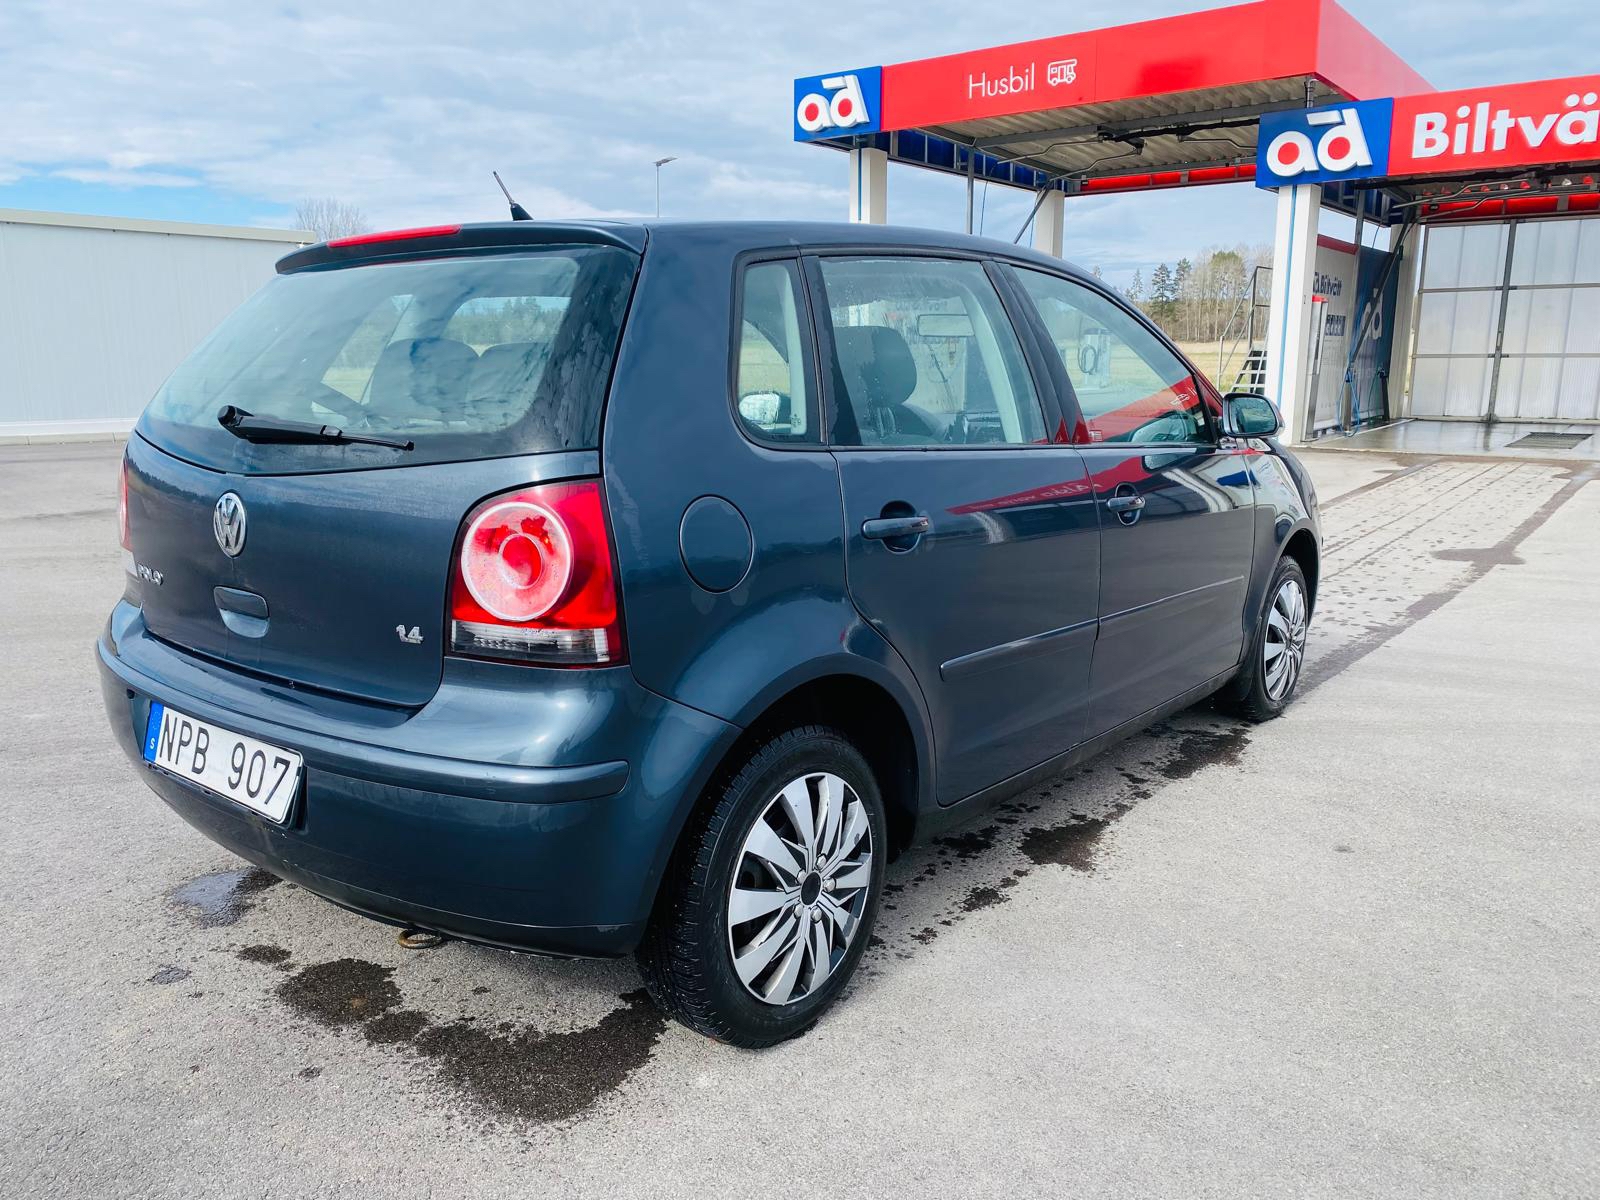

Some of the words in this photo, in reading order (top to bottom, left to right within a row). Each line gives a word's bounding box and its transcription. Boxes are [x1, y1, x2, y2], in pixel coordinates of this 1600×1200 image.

[968, 63, 1035, 99] Husbil
[1411, 92, 1600, 159] Biltvä
[149, 737, 156, 750] S
[159, 713, 210, 775] NPB
[227, 741, 291, 805] 907
